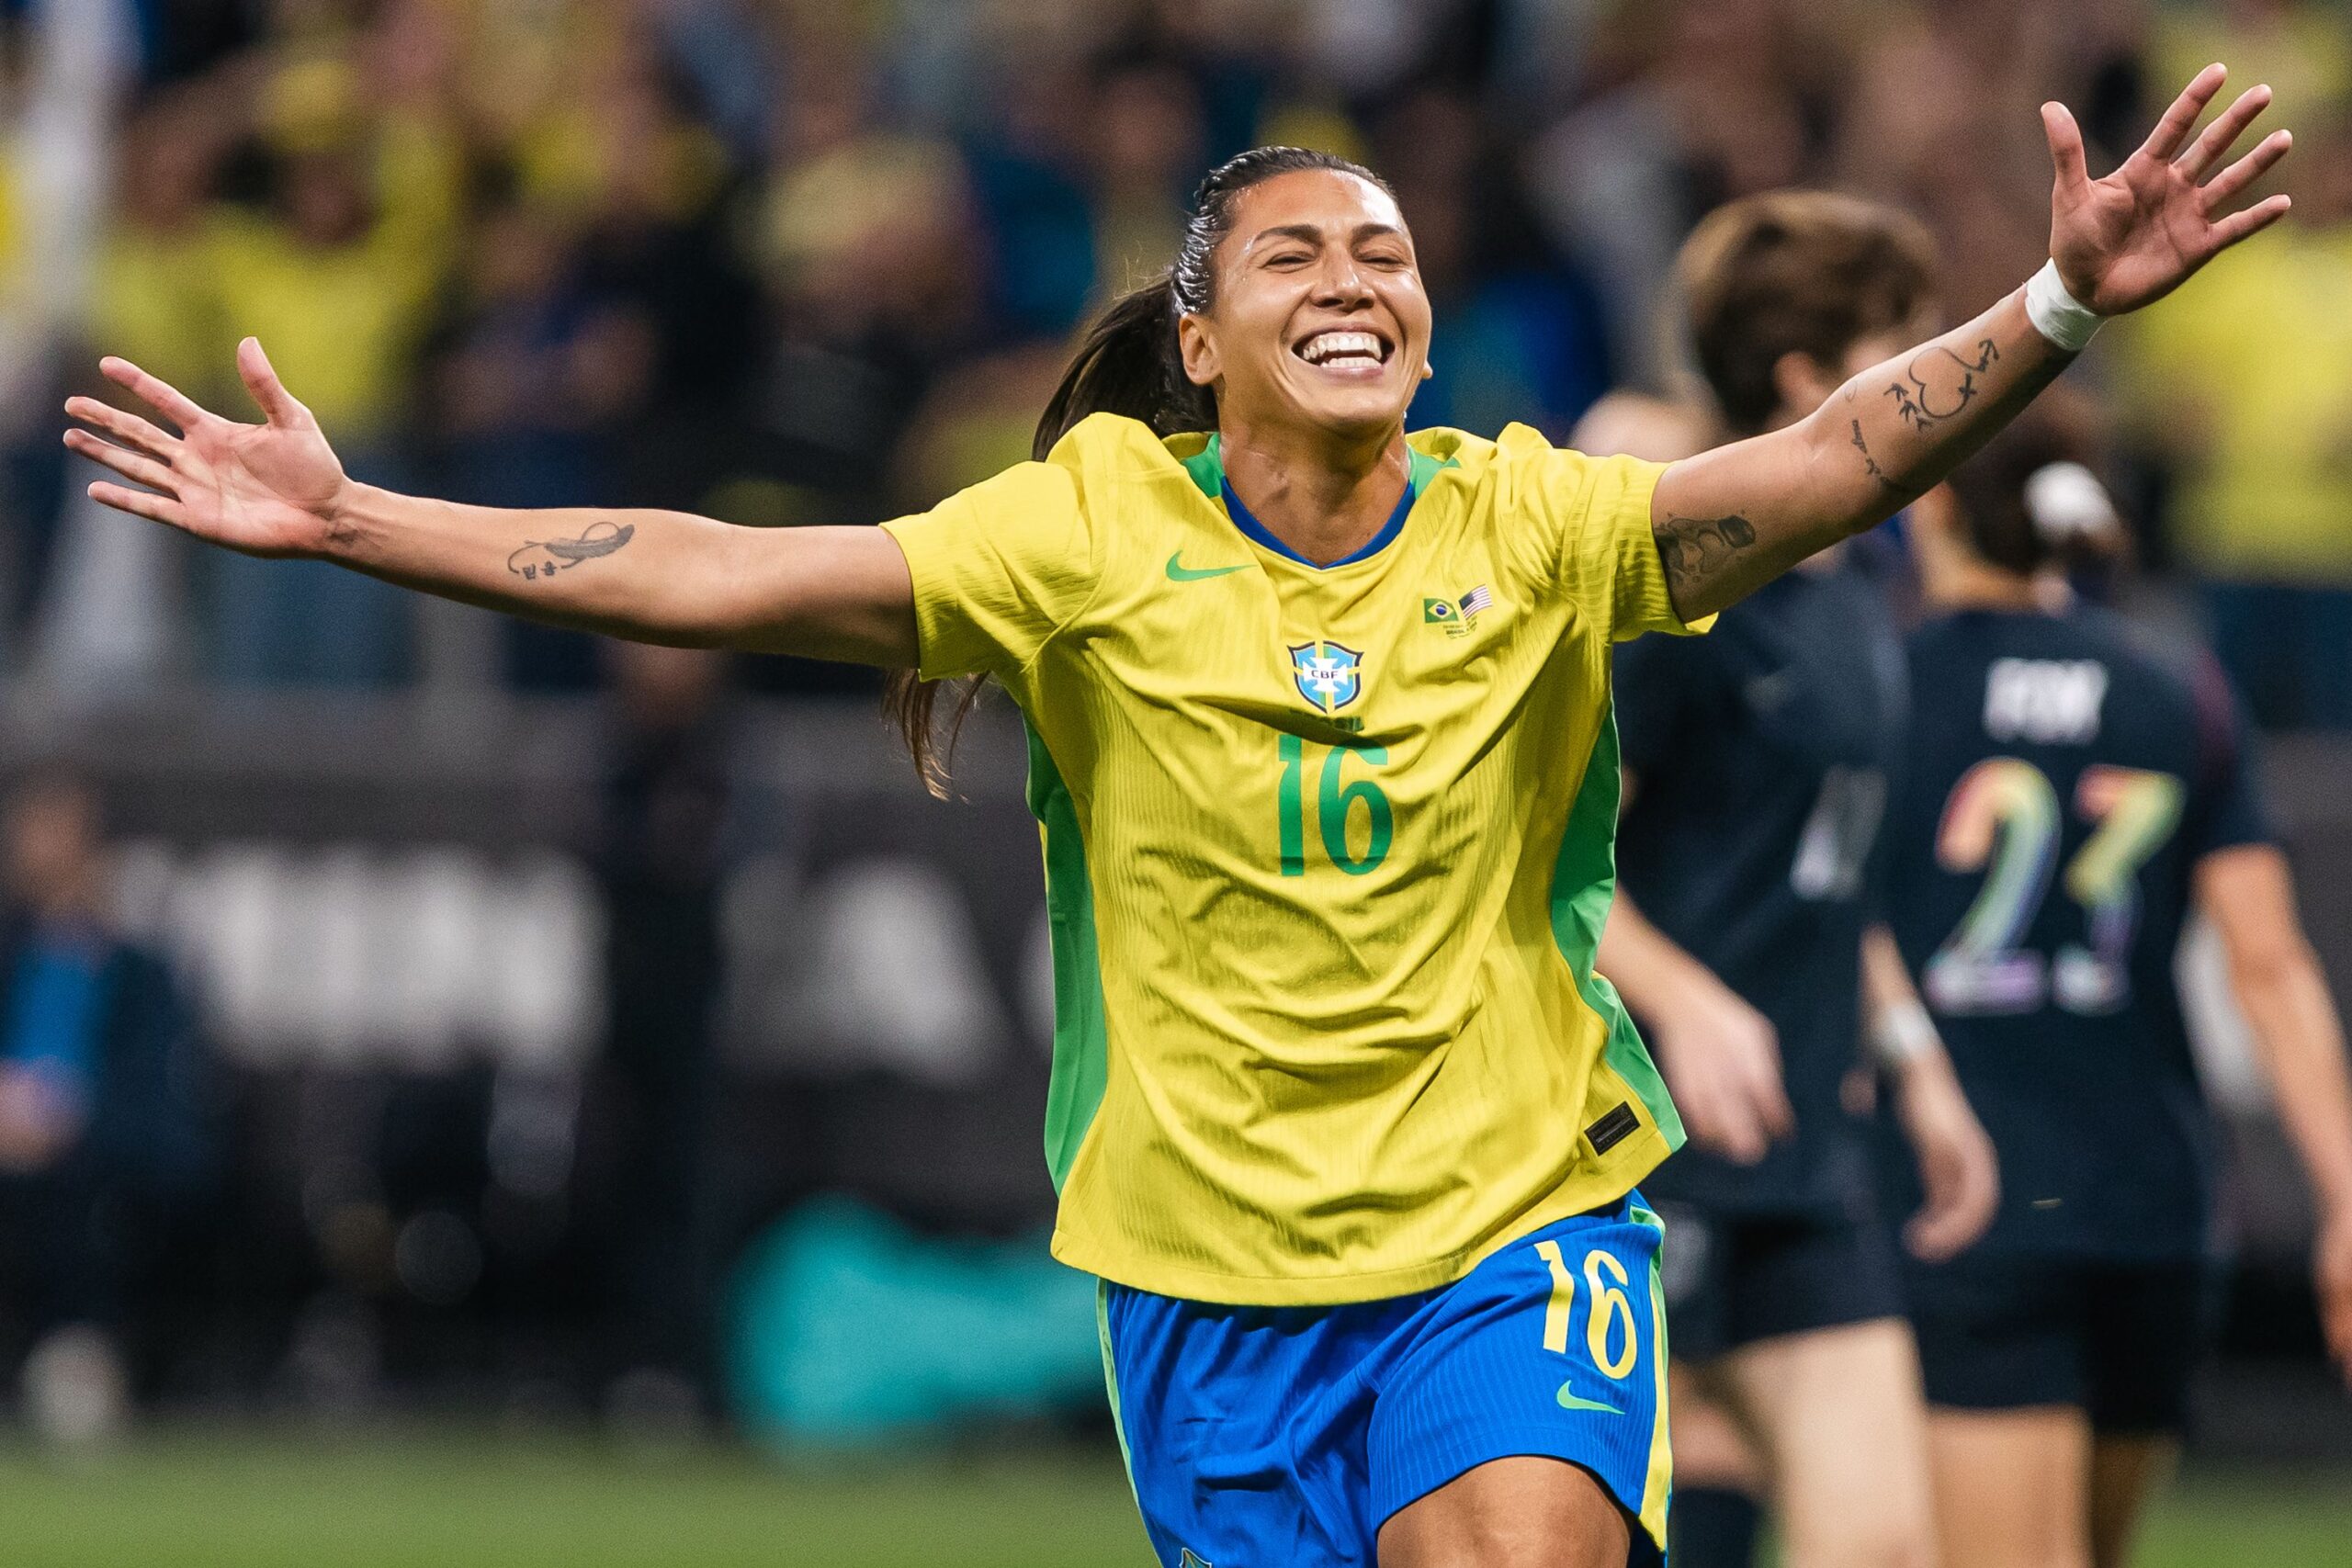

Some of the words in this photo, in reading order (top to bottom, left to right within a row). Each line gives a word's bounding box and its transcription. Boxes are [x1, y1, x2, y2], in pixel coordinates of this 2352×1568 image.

[1310, 670, 1340, 680] CBF
[1278, 734, 1394, 877] 16
[1924, 756, 2187, 1016] 23
[1533, 1240, 1637, 1380] 16
